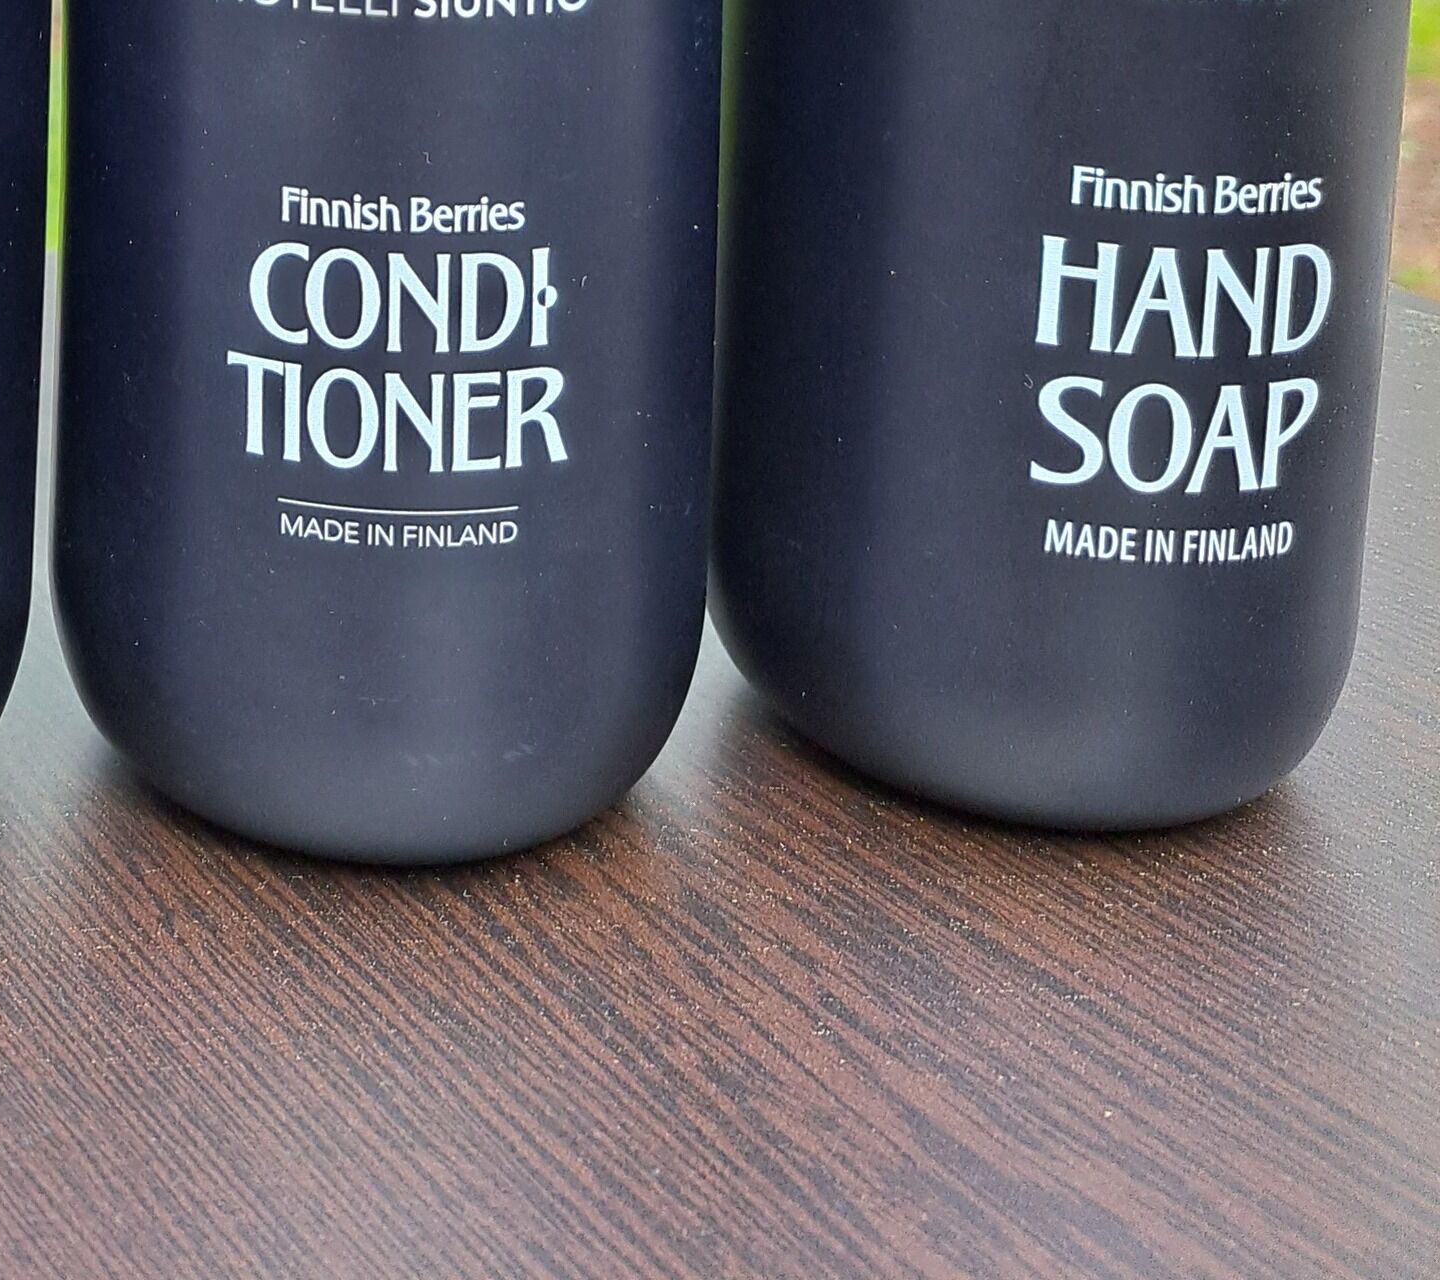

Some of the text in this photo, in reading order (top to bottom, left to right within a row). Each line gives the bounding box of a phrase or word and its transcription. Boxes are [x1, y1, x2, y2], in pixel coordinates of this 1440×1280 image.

[281, 185, 526, 234] Finnish Berries
[1070, 164, 1324, 216] Finnish Berries
[1034, 234, 1335, 359] HAND
[226, 348, 570, 474] TIONER
[1029, 375, 1320, 496] SOAP
[280, 512, 519, 550] MADE IN FINLAND
[1043, 518, 1294, 566] MADE IN FINLAND
